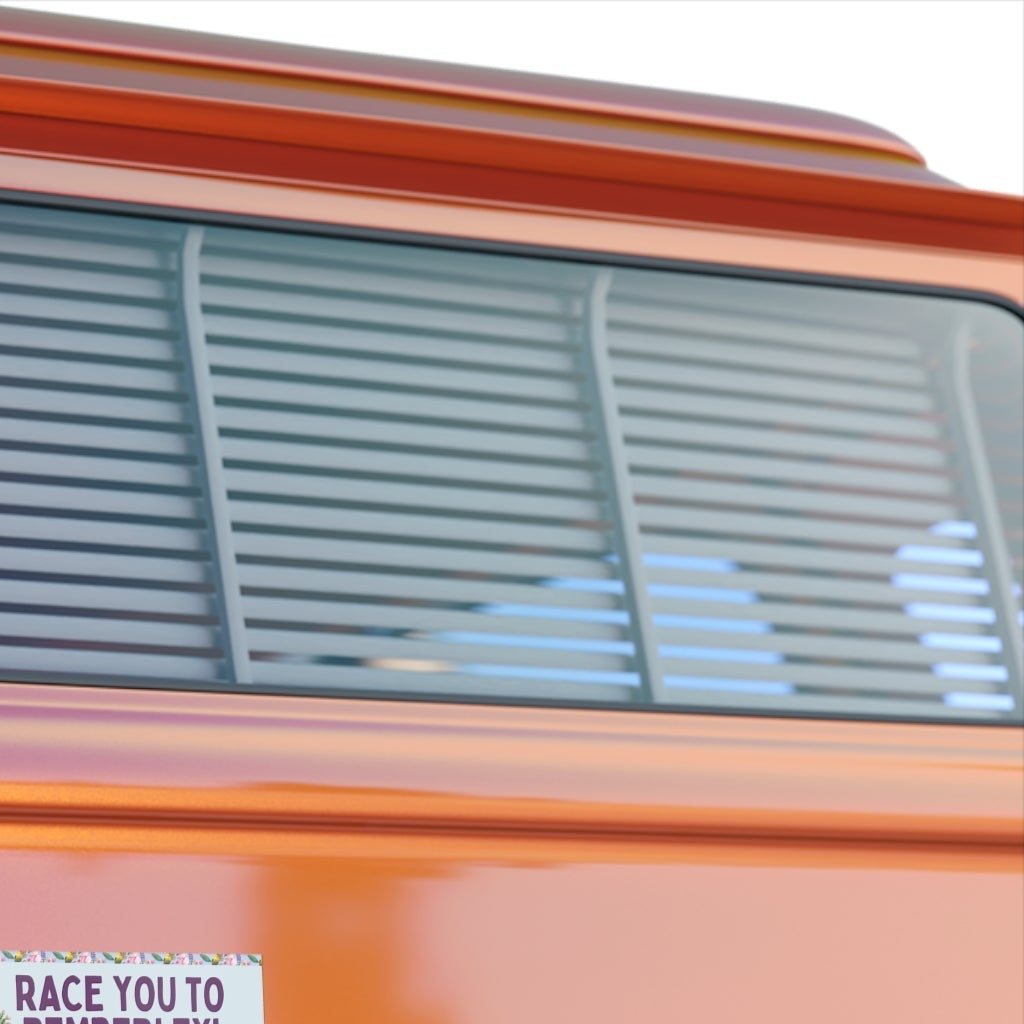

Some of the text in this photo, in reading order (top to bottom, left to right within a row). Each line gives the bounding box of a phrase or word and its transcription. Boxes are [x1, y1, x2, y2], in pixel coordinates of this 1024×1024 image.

[15, 974, 225, 1013] RACE YOU TO
